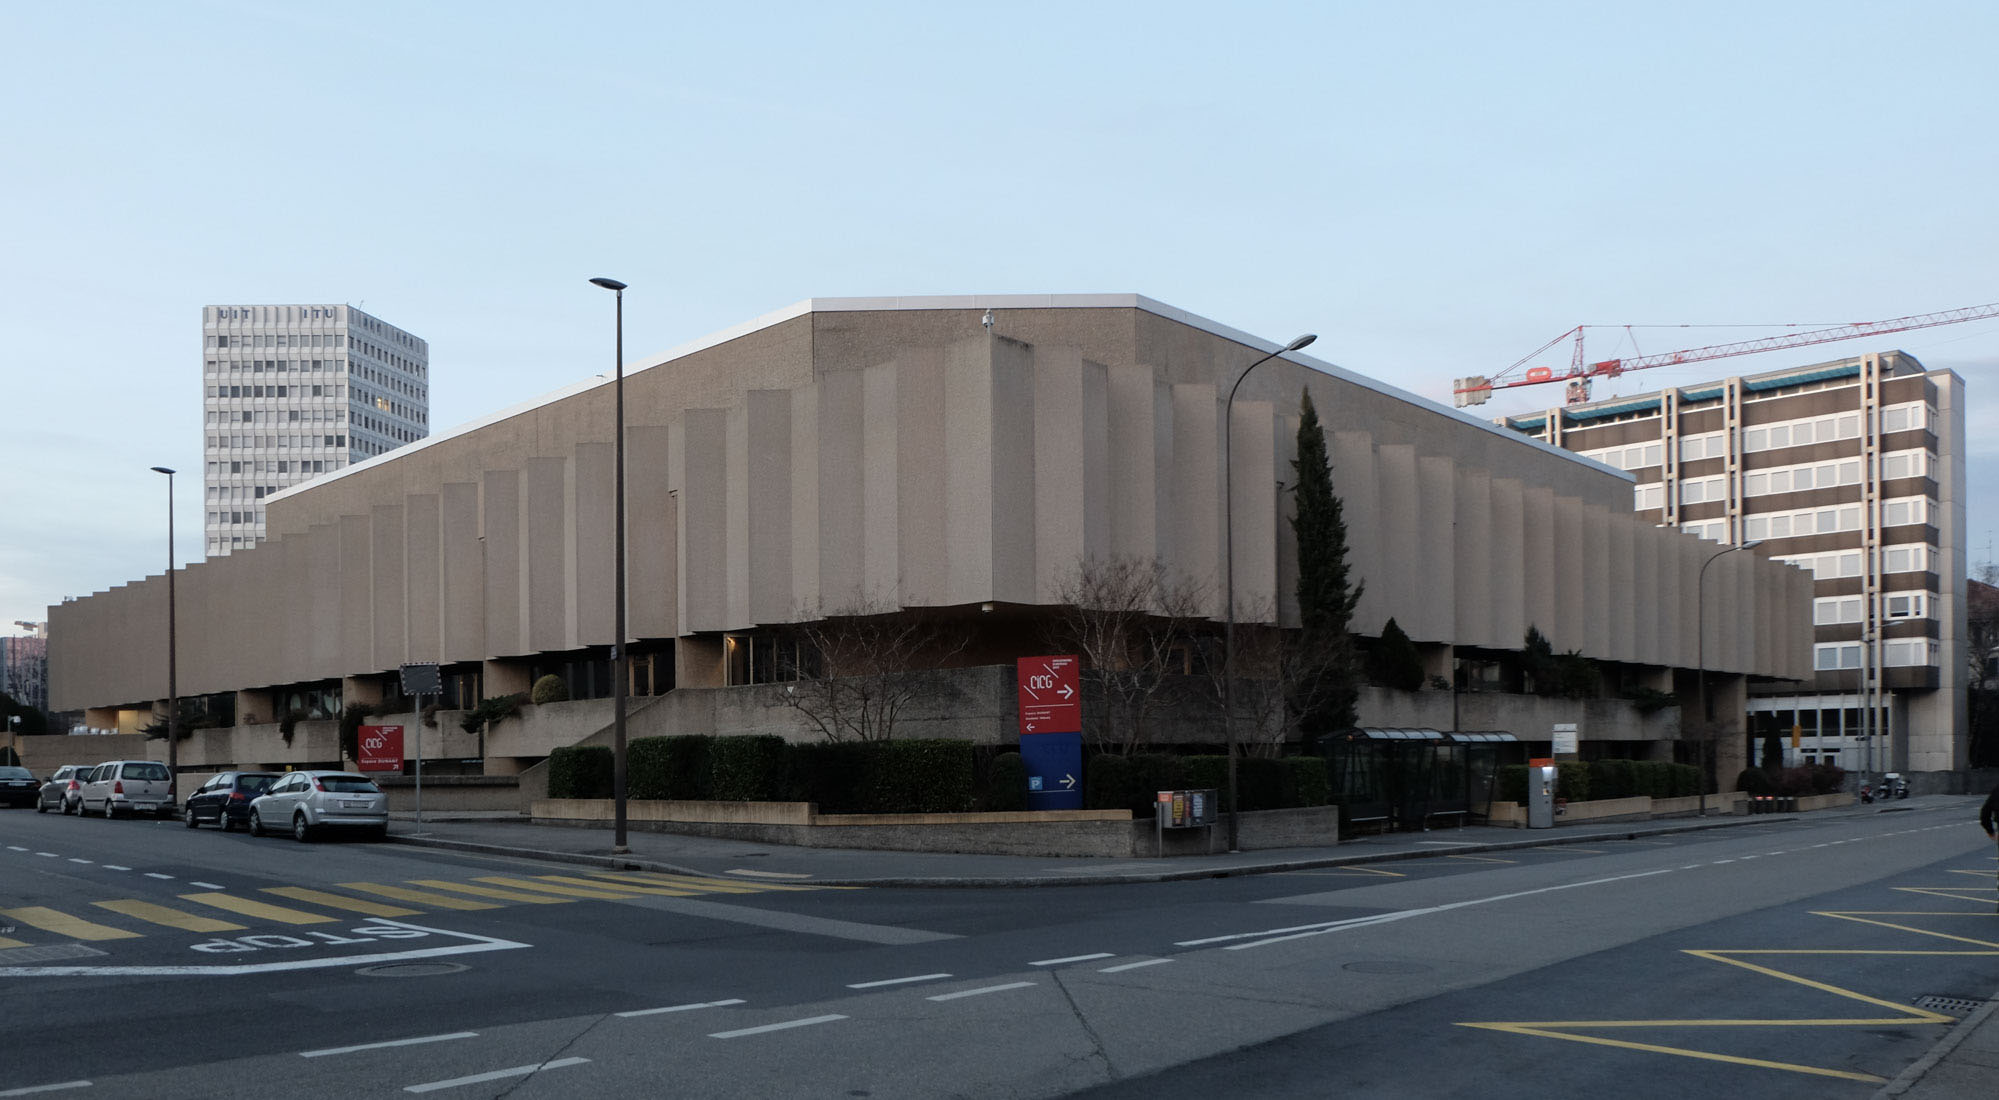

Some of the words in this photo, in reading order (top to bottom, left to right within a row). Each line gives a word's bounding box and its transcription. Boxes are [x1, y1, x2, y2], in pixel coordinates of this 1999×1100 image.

[219, 309, 250, 319] UIT
[303, 309, 334, 319] ITU
[189, 926, 431, 953] STOP
